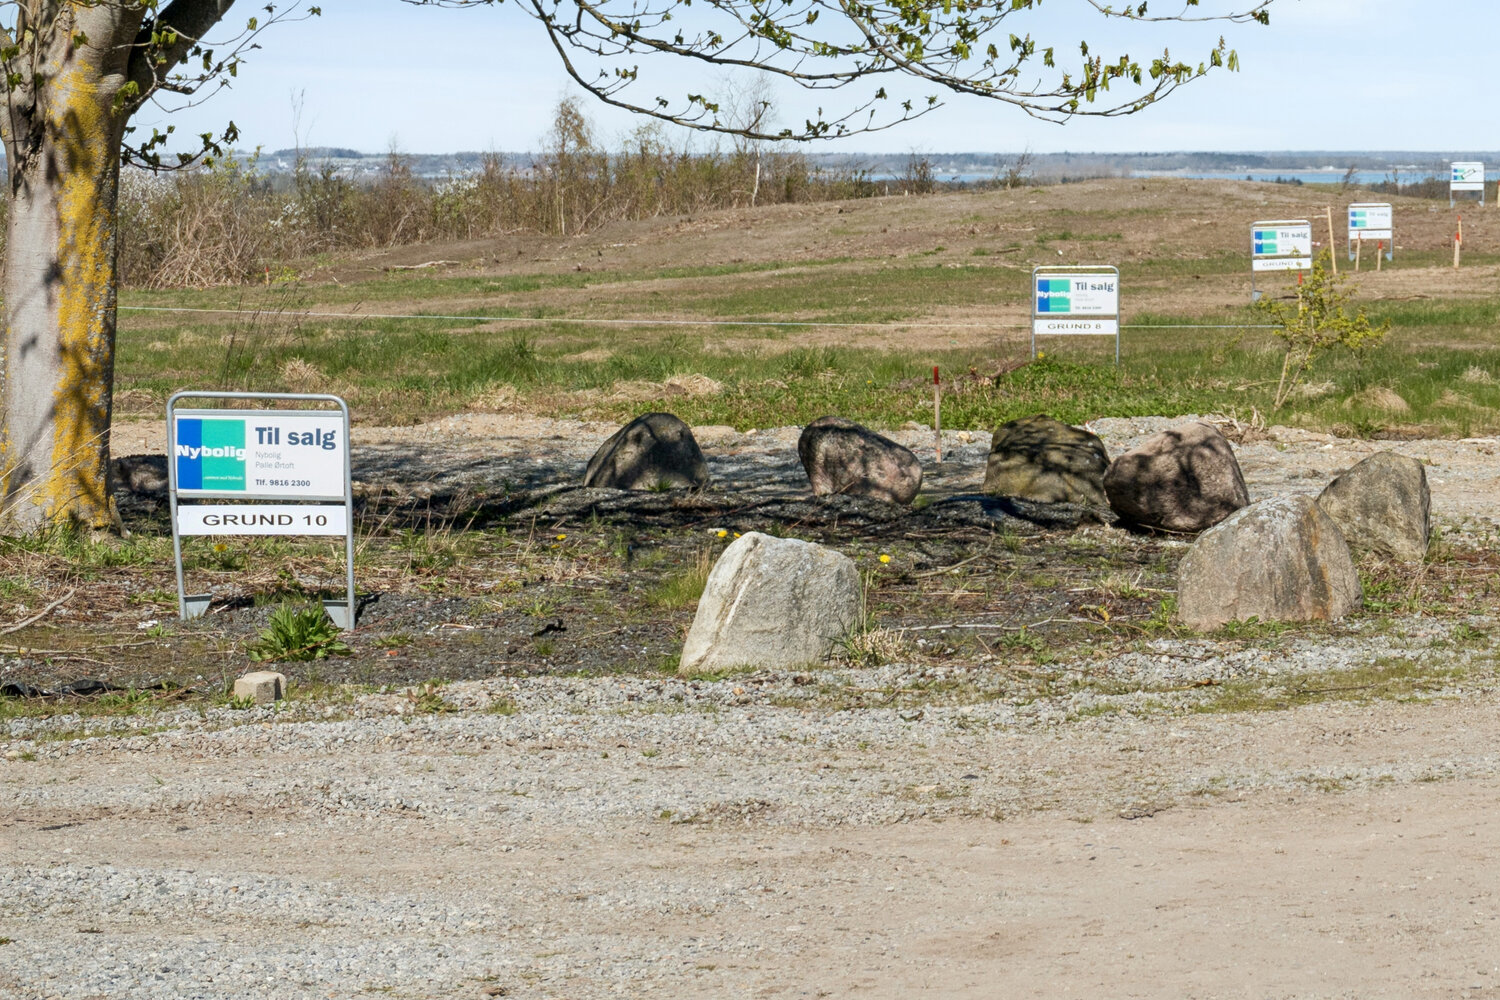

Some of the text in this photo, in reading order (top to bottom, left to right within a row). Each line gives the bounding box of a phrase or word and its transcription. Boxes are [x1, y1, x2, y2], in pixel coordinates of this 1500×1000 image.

[1075, 282, 1114, 293] Til salg
[255, 426, 337, 451] Til salg
[176, 444, 246, 461] Nybolig
[255, 451, 281, 460] Nybolig
[255, 461, 273, 469] Palle
[269, 479, 289, 487] 9816
[291, 479, 311, 487] 2300
[202, 514, 328, 527] GRUND 10
